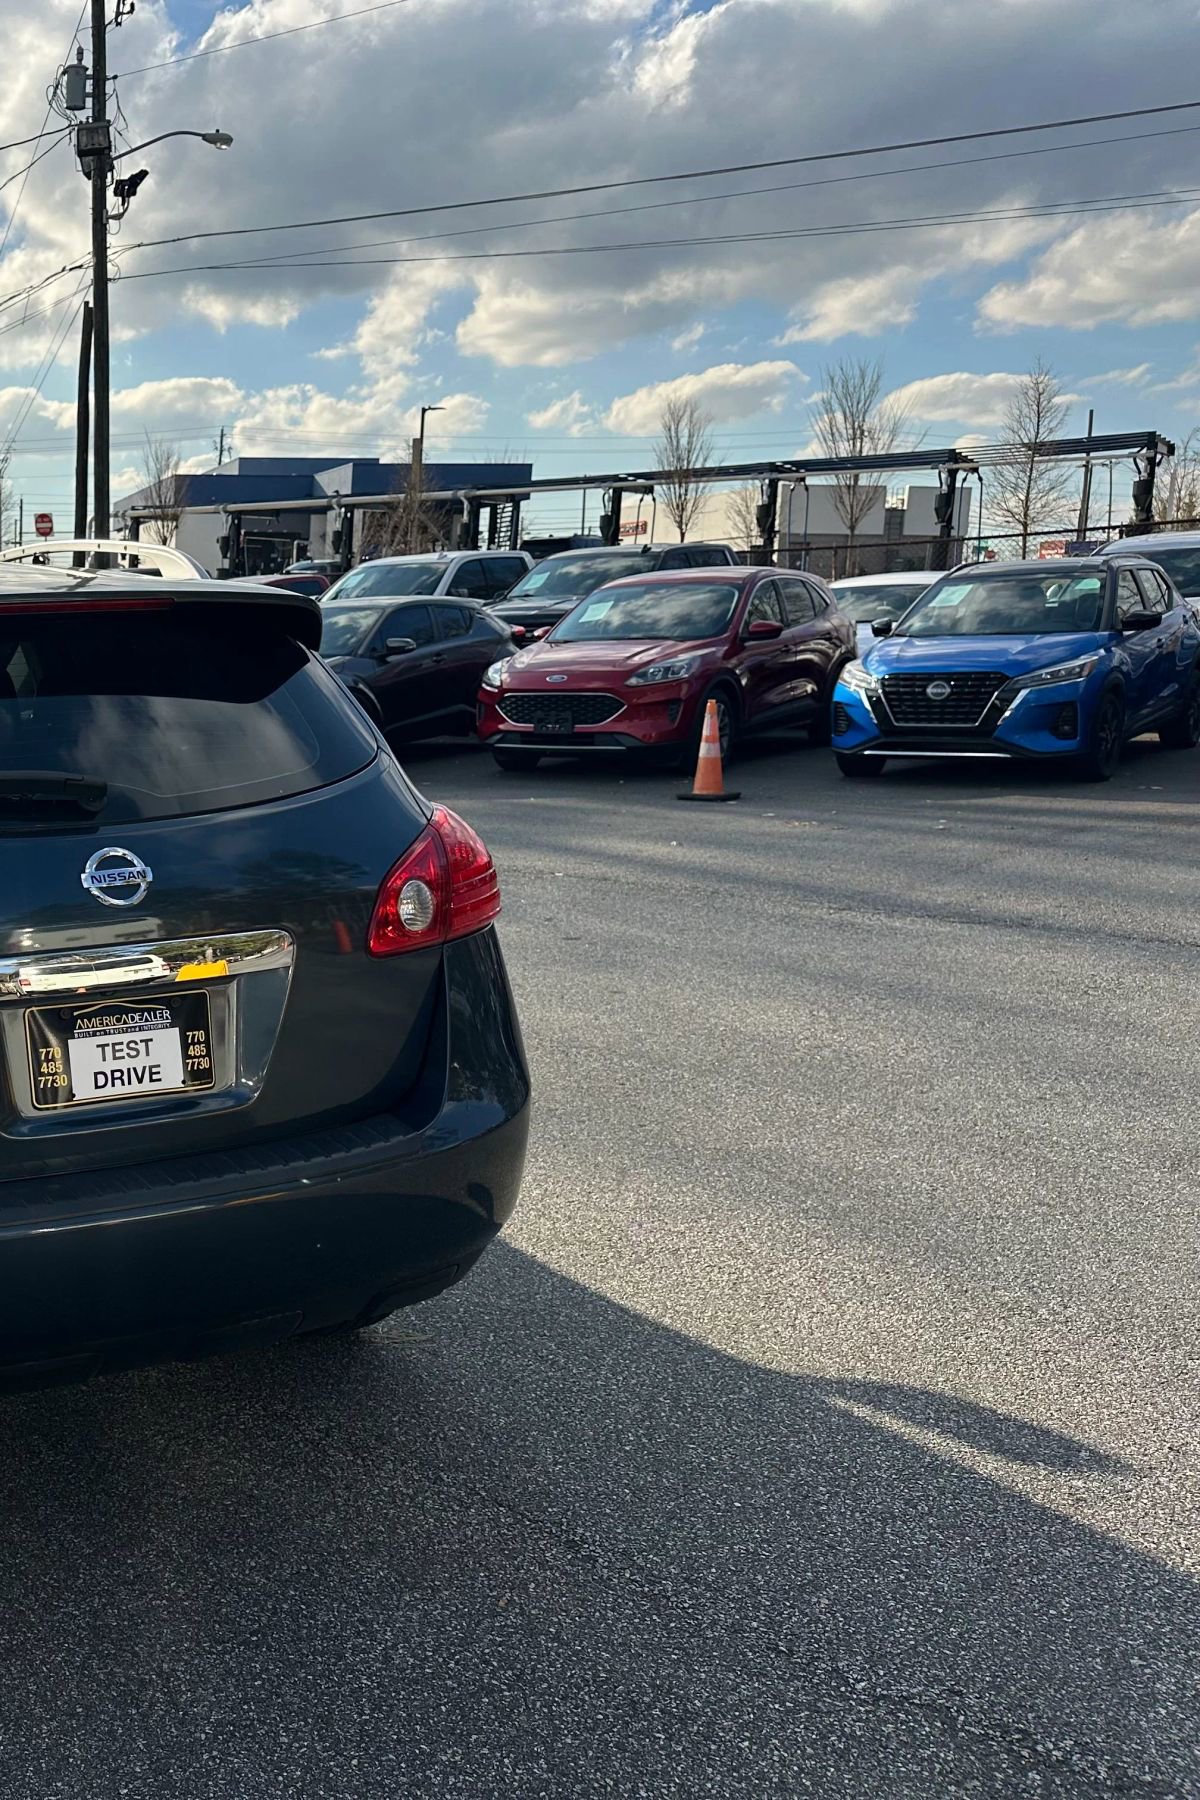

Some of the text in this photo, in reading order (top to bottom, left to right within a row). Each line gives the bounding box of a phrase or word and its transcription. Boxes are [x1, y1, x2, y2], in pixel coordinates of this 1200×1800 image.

[90, 869, 147, 885] NISSAN
[75, 1009, 171, 1030] AMERICADEALER
[74, 1031, 93, 1039] BUILT
[140, 1023, 170, 1031] INTEGRITY
[186, 1031, 205, 1043] 770
[39, 1047, 61, 1060] 770
[96, 1038, 153, 1062] TEST
[187, 1044, 207, 1056] 485
[40, 1061, 63, 1074] 485
[185, 1057, 210, 1071] 7730
[37, 1075, 68, 1089] 7730
[93, 1064, 162, 1090] DRIVE
